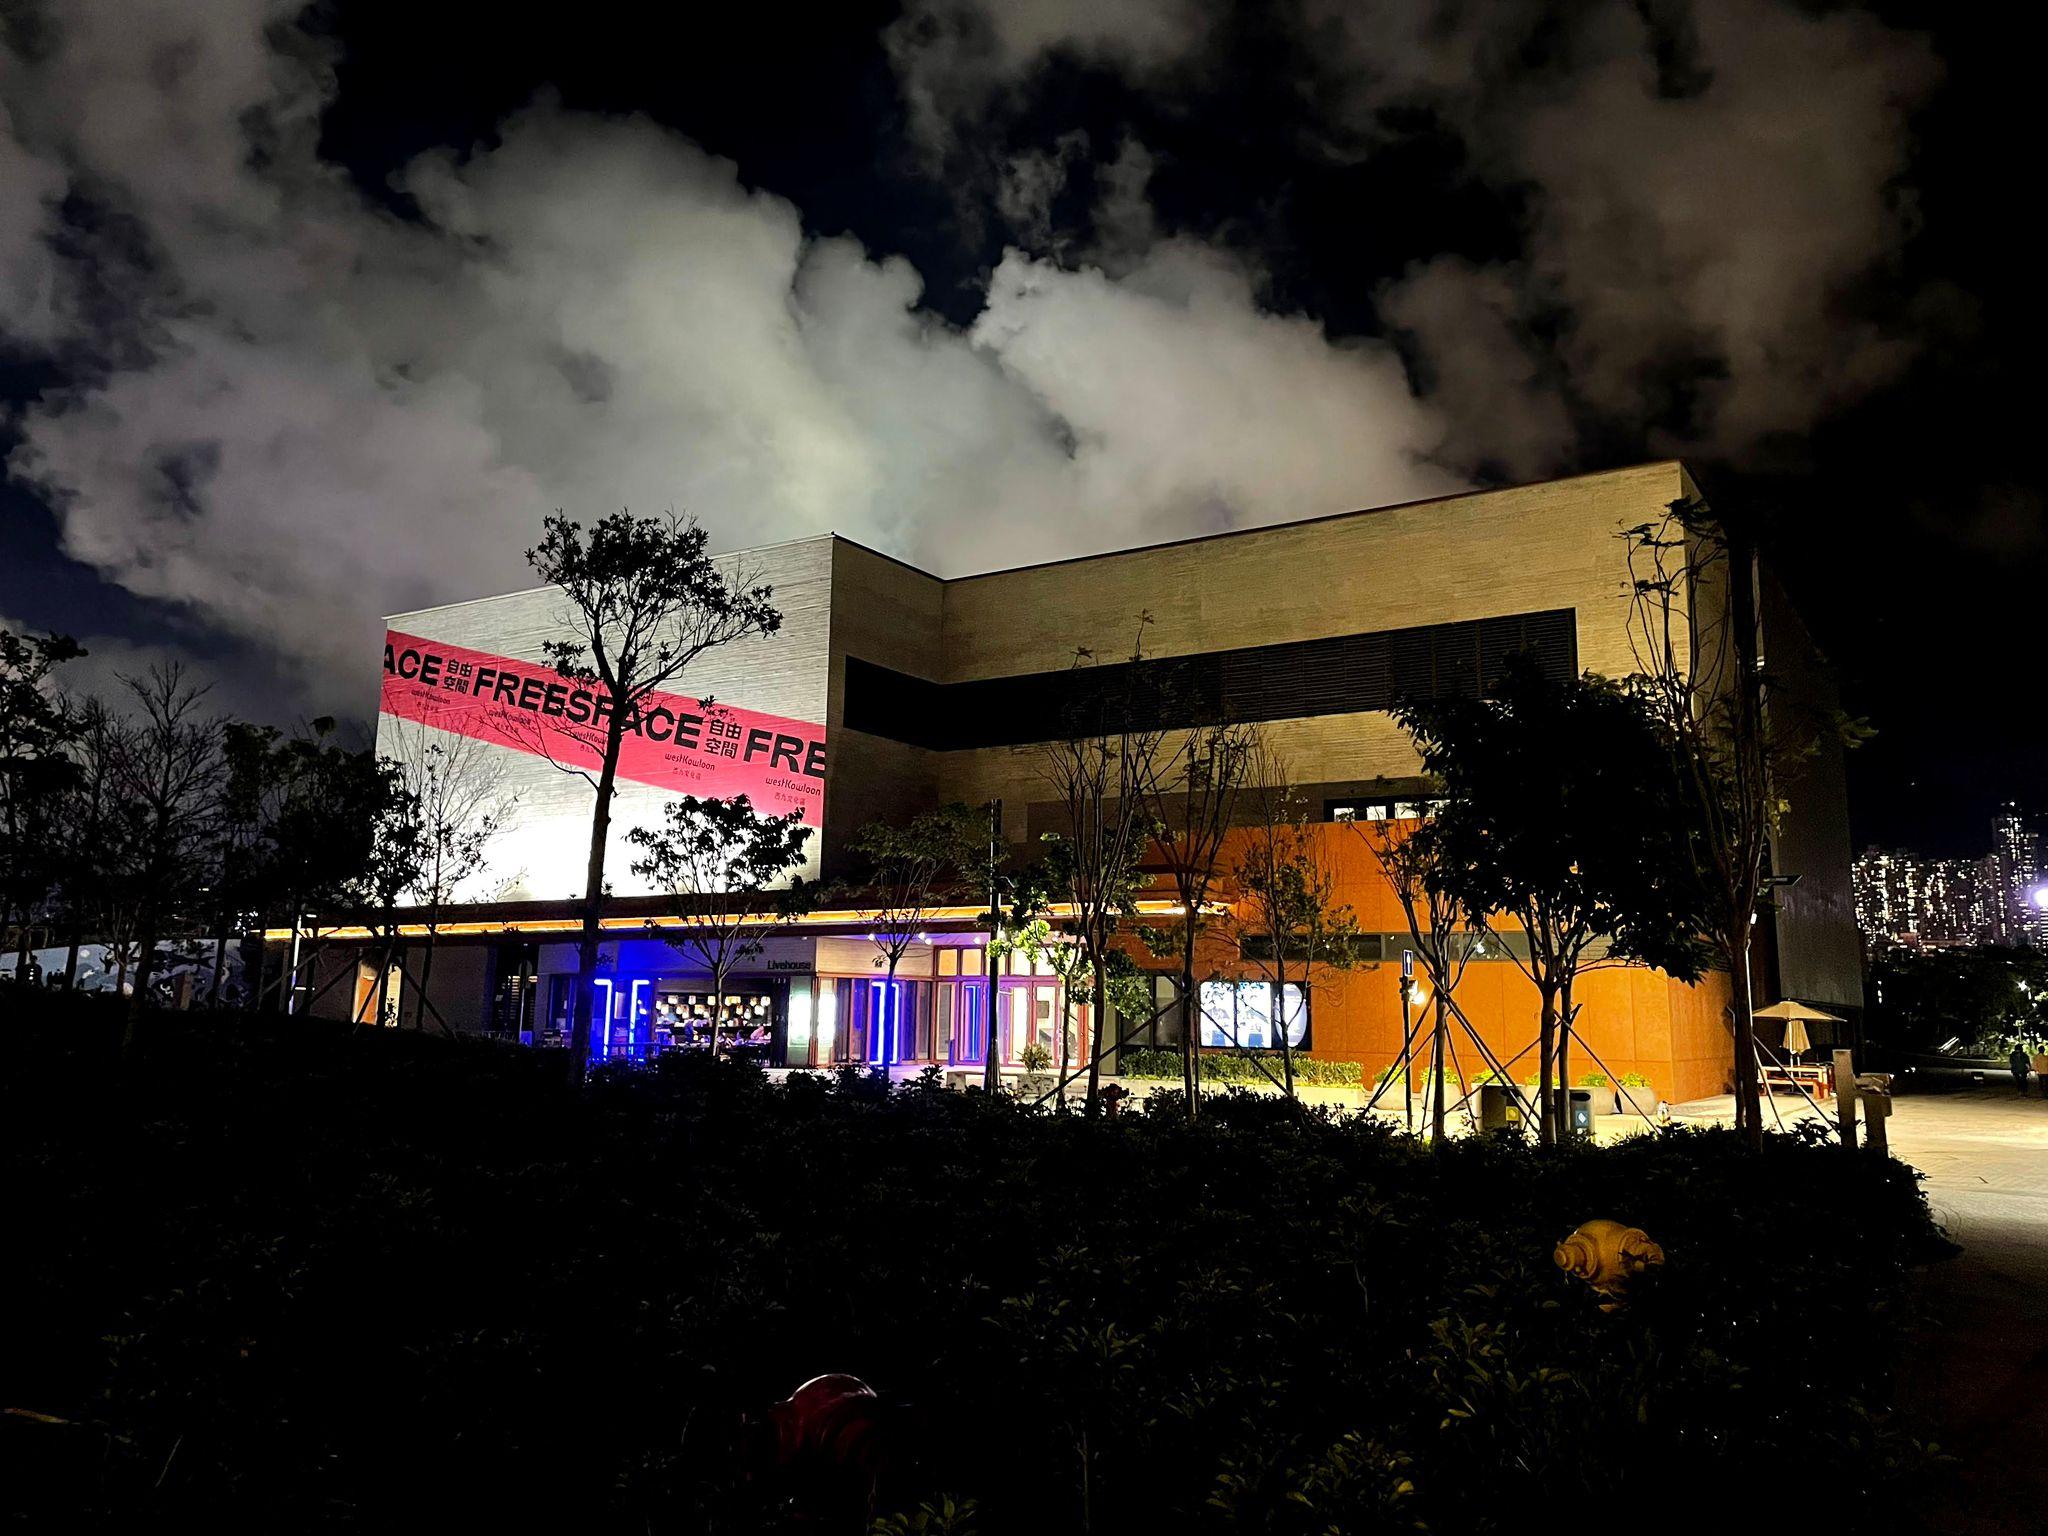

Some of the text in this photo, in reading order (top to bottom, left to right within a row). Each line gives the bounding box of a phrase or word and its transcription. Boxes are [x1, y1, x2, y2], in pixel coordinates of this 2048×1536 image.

[447, 659, 472, 677] 自由
[443, 676, 469, 694] 空間
[473, 666, 704, 750] FREESPACE
[709, 719, 742, 739] 自由
[704, 737, 739, 760] 空間
[743, 728, 826, 779] FRE
[664, 751, 716, 772] westKowloon
[765, 776, 821, 797] westKowloon
[767, 960, 812, 970] Livehouse
